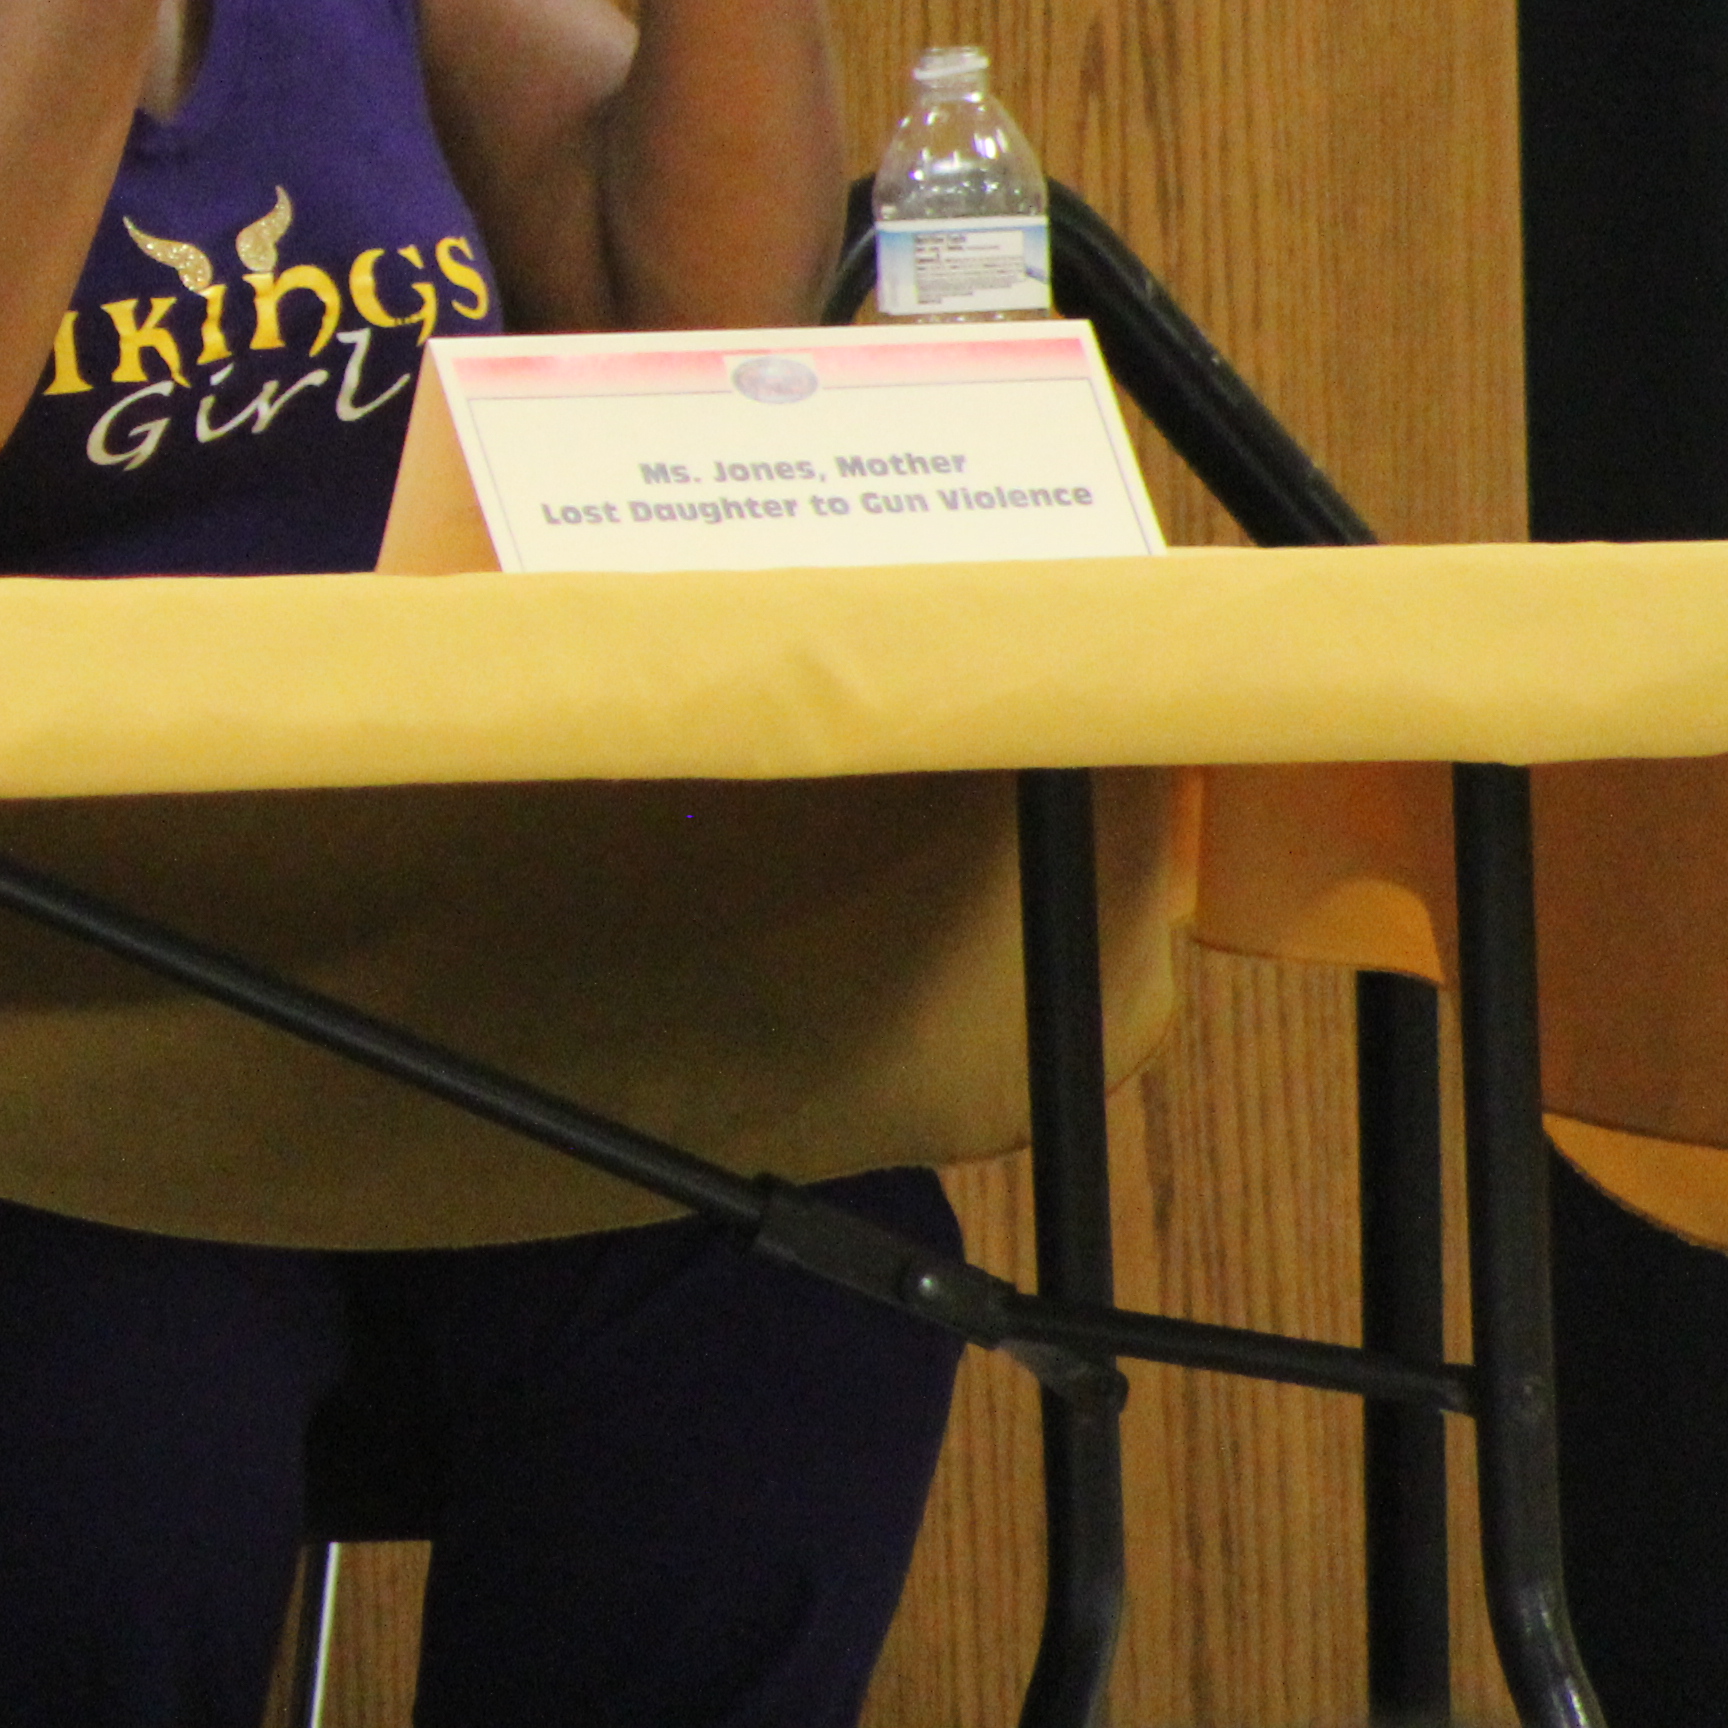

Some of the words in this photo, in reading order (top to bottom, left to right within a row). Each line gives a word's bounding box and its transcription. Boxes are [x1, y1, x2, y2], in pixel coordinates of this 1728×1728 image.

[85, 327, 411, 472] Girl
[639, 461, 702, 485] Ms.
[714, 459, 827, 484] Jones,
[834, 452, 967, 479] Mother
[540, 501, 622, 526] Lost
[628, 496, 800, 526] Daughter
[809, 494, 852, 518] to
[860, 491, 931, 516] Gun
[936, 485, 1095, 512] Violence
